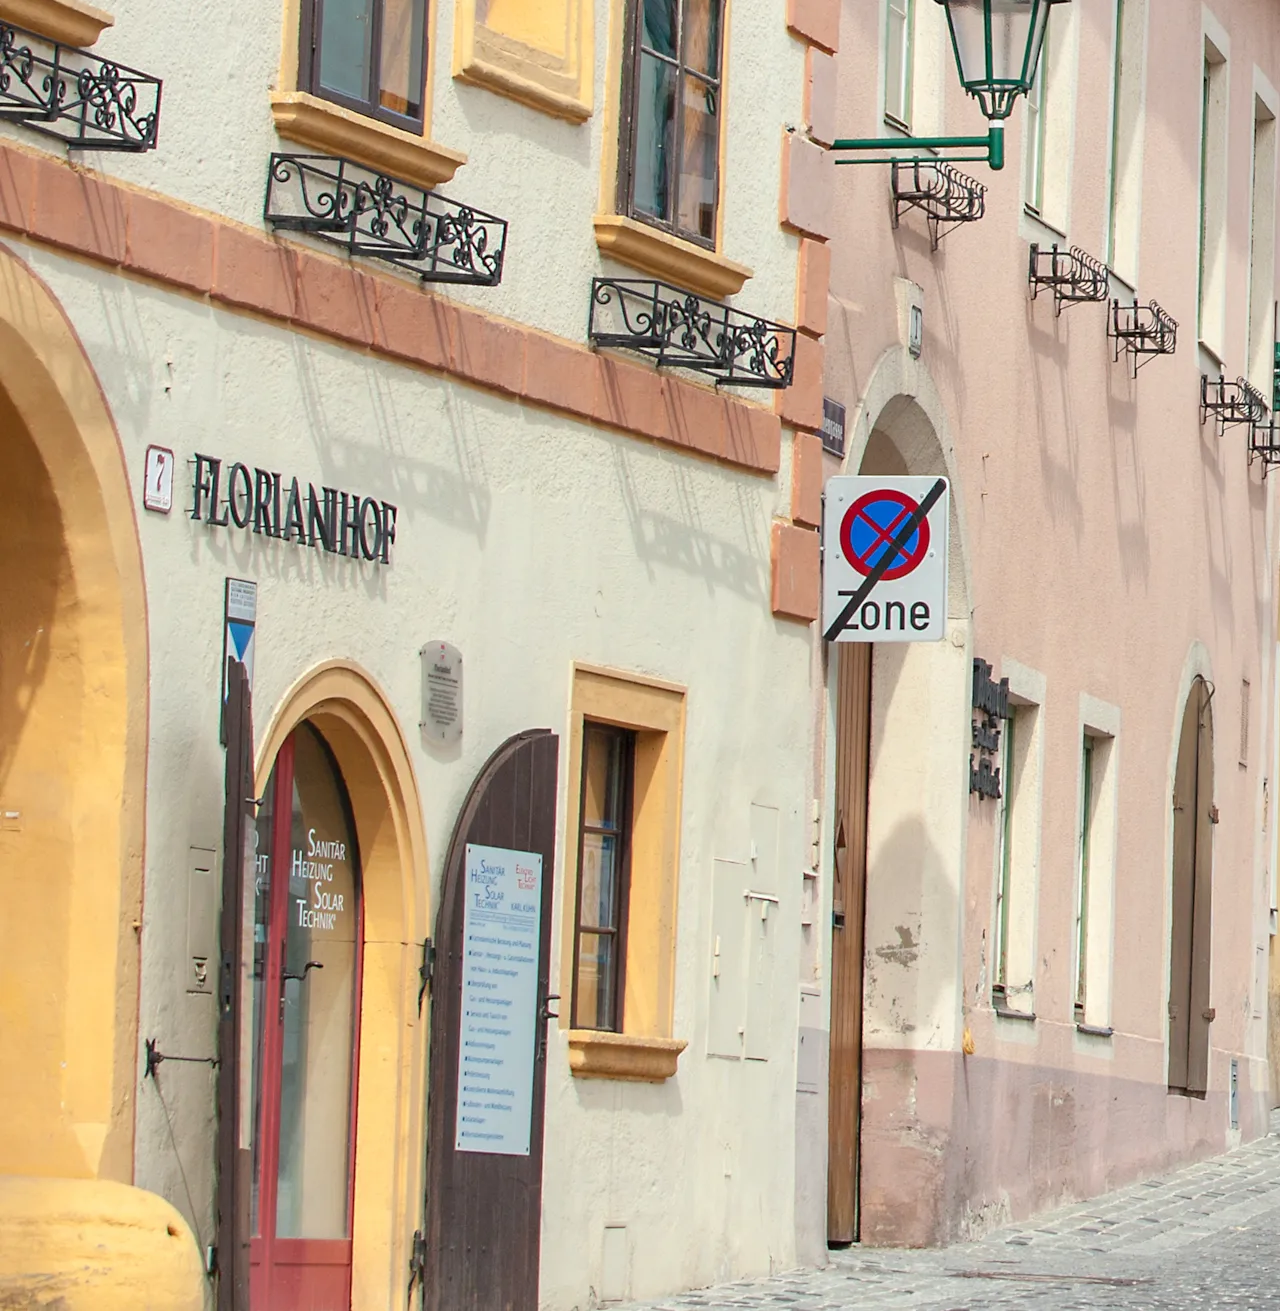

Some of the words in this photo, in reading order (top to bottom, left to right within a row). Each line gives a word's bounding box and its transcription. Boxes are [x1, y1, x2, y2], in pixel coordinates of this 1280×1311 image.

[190, 452, 398, 564] FLORIANIHOF
[838, 590, 930, 631] Zone
[292, 849, 333, 881] HEIZUNG
[314, 881, 344, 912] SOLAR
